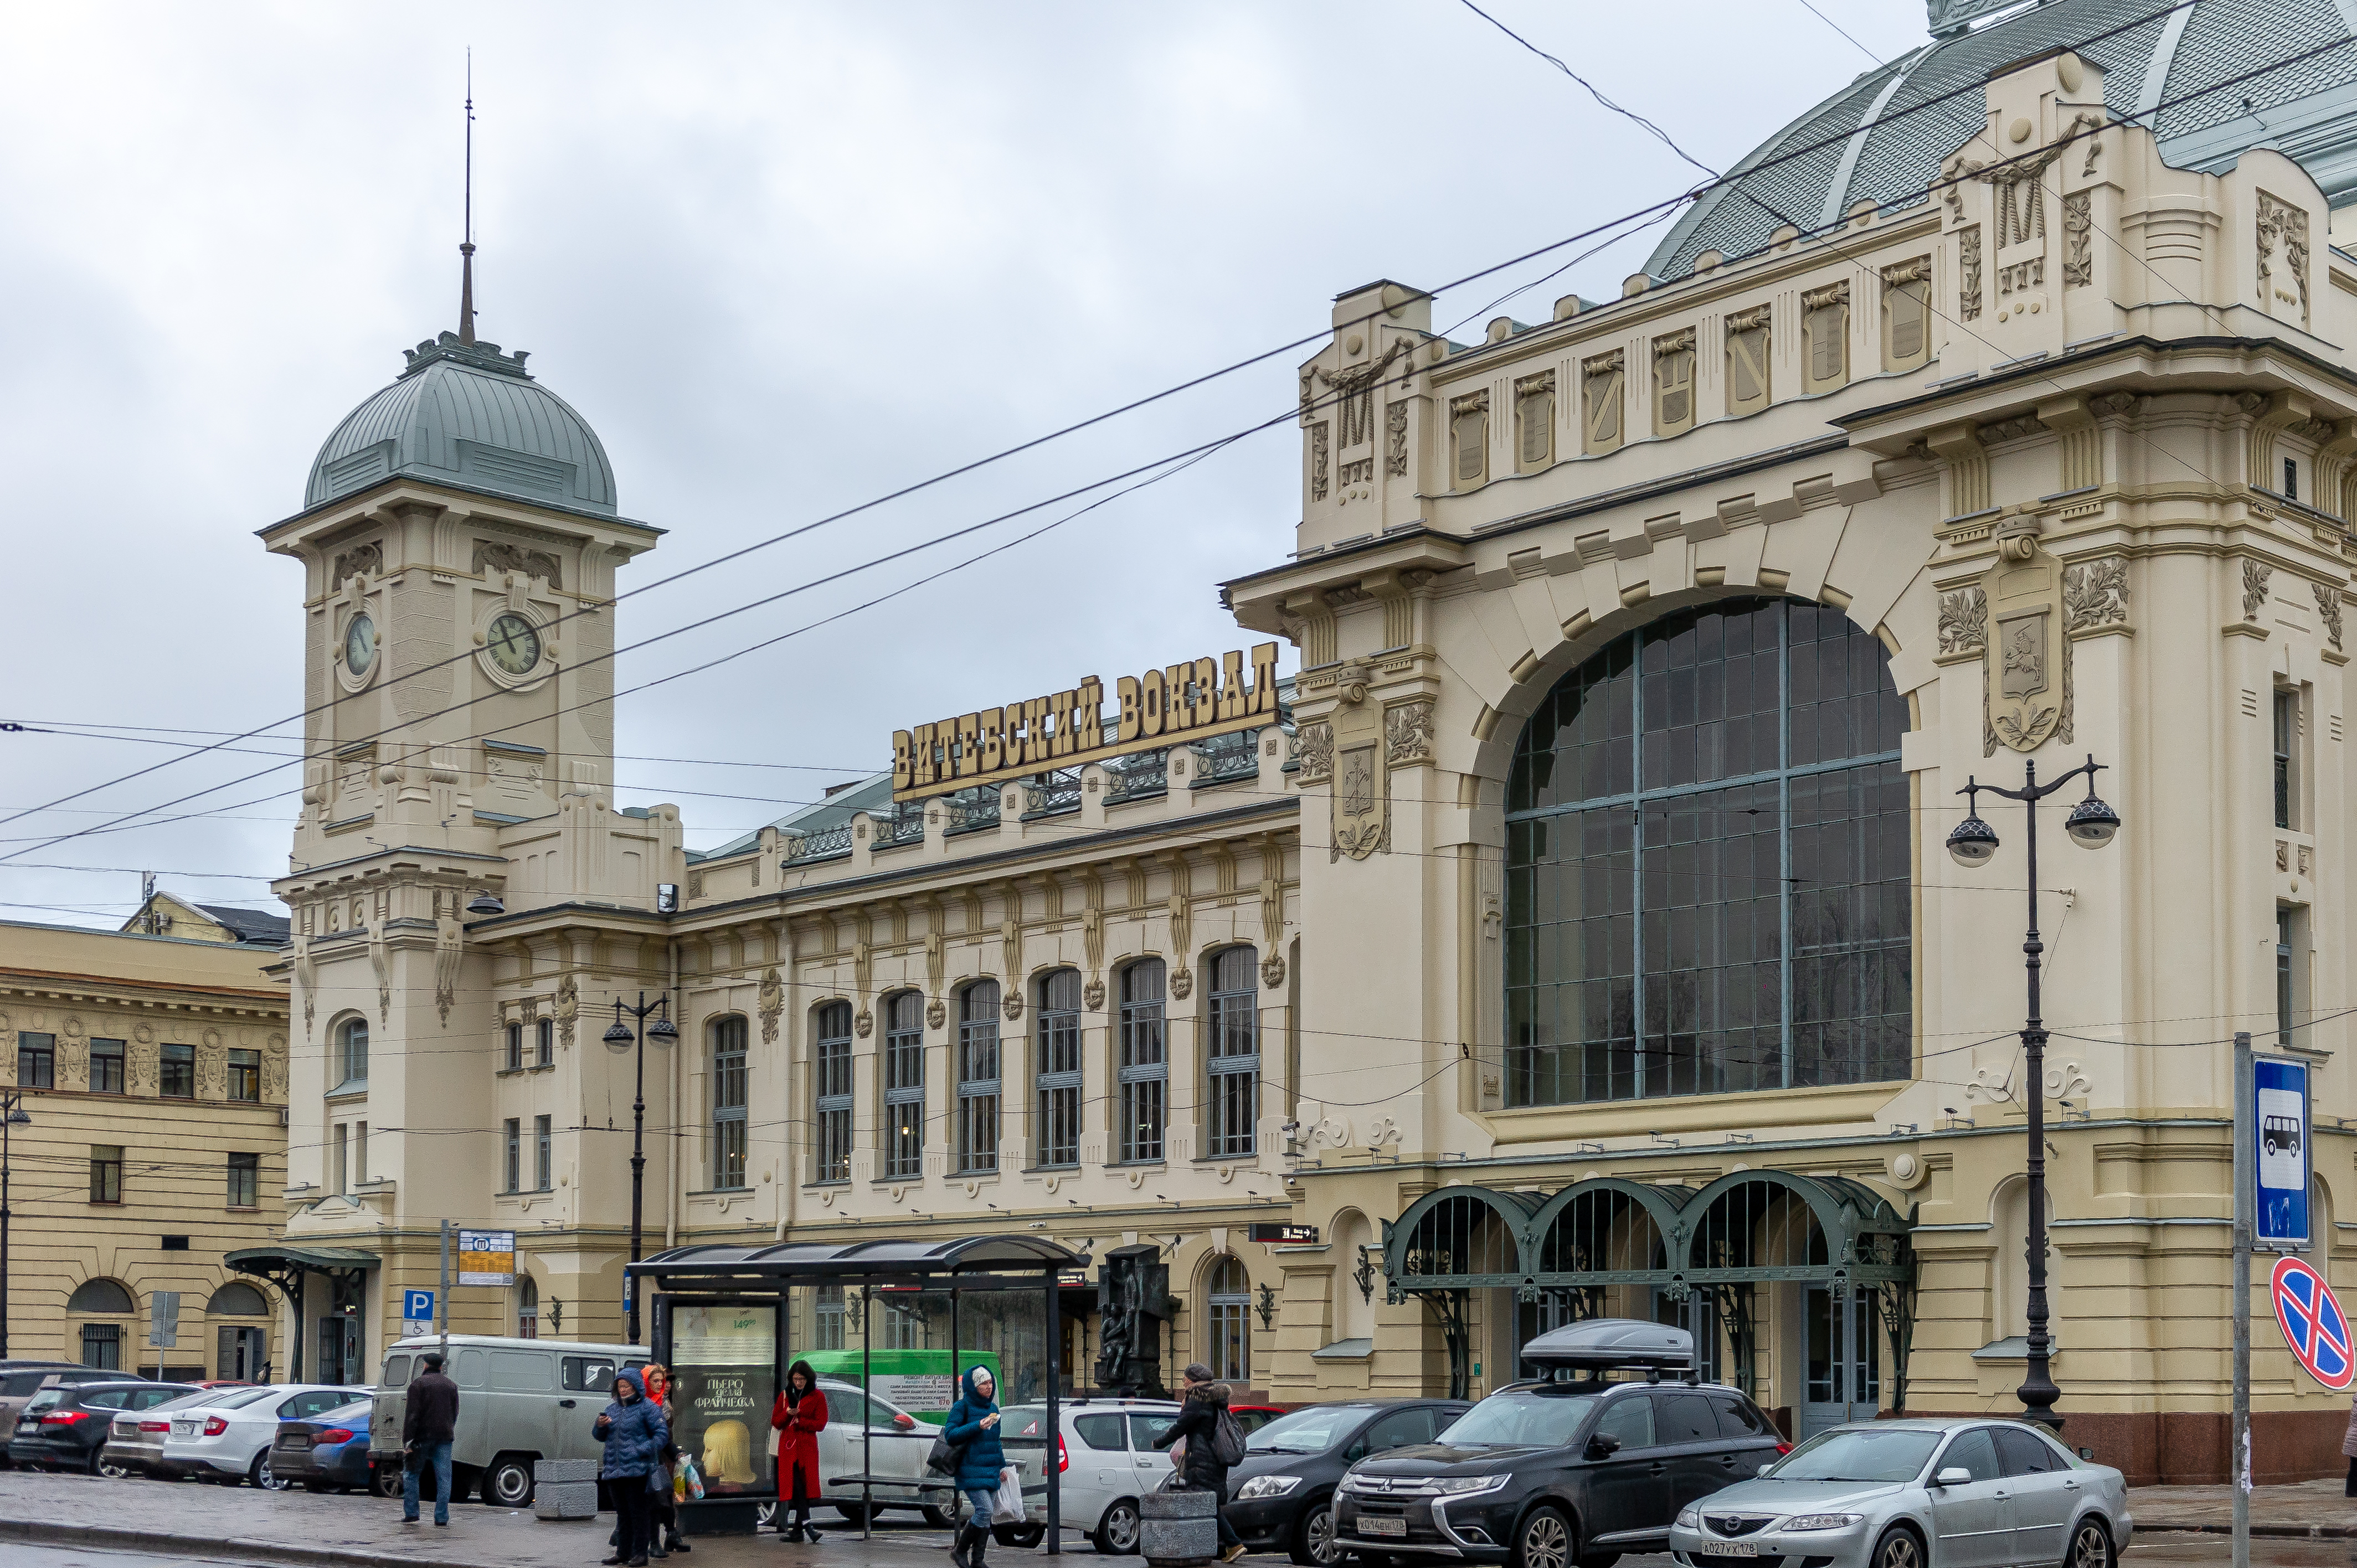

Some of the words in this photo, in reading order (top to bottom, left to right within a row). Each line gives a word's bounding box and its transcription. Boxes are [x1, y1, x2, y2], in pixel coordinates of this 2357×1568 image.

[892, 675, 1104, 790] ВИТЕБСКИЙ
[1117, 641, 1279, 742] ВОКЗАЛ
[412, 1294, 429, 1317] P
[707, 1379, 743, 1389] ПЬЕРО
[694, 1396, 755, 1407] ФРАНЧЕСКА
[1704, 1543, 1738, 1555] А027УХ
[1740, 1543, 1754, 1552] 178
